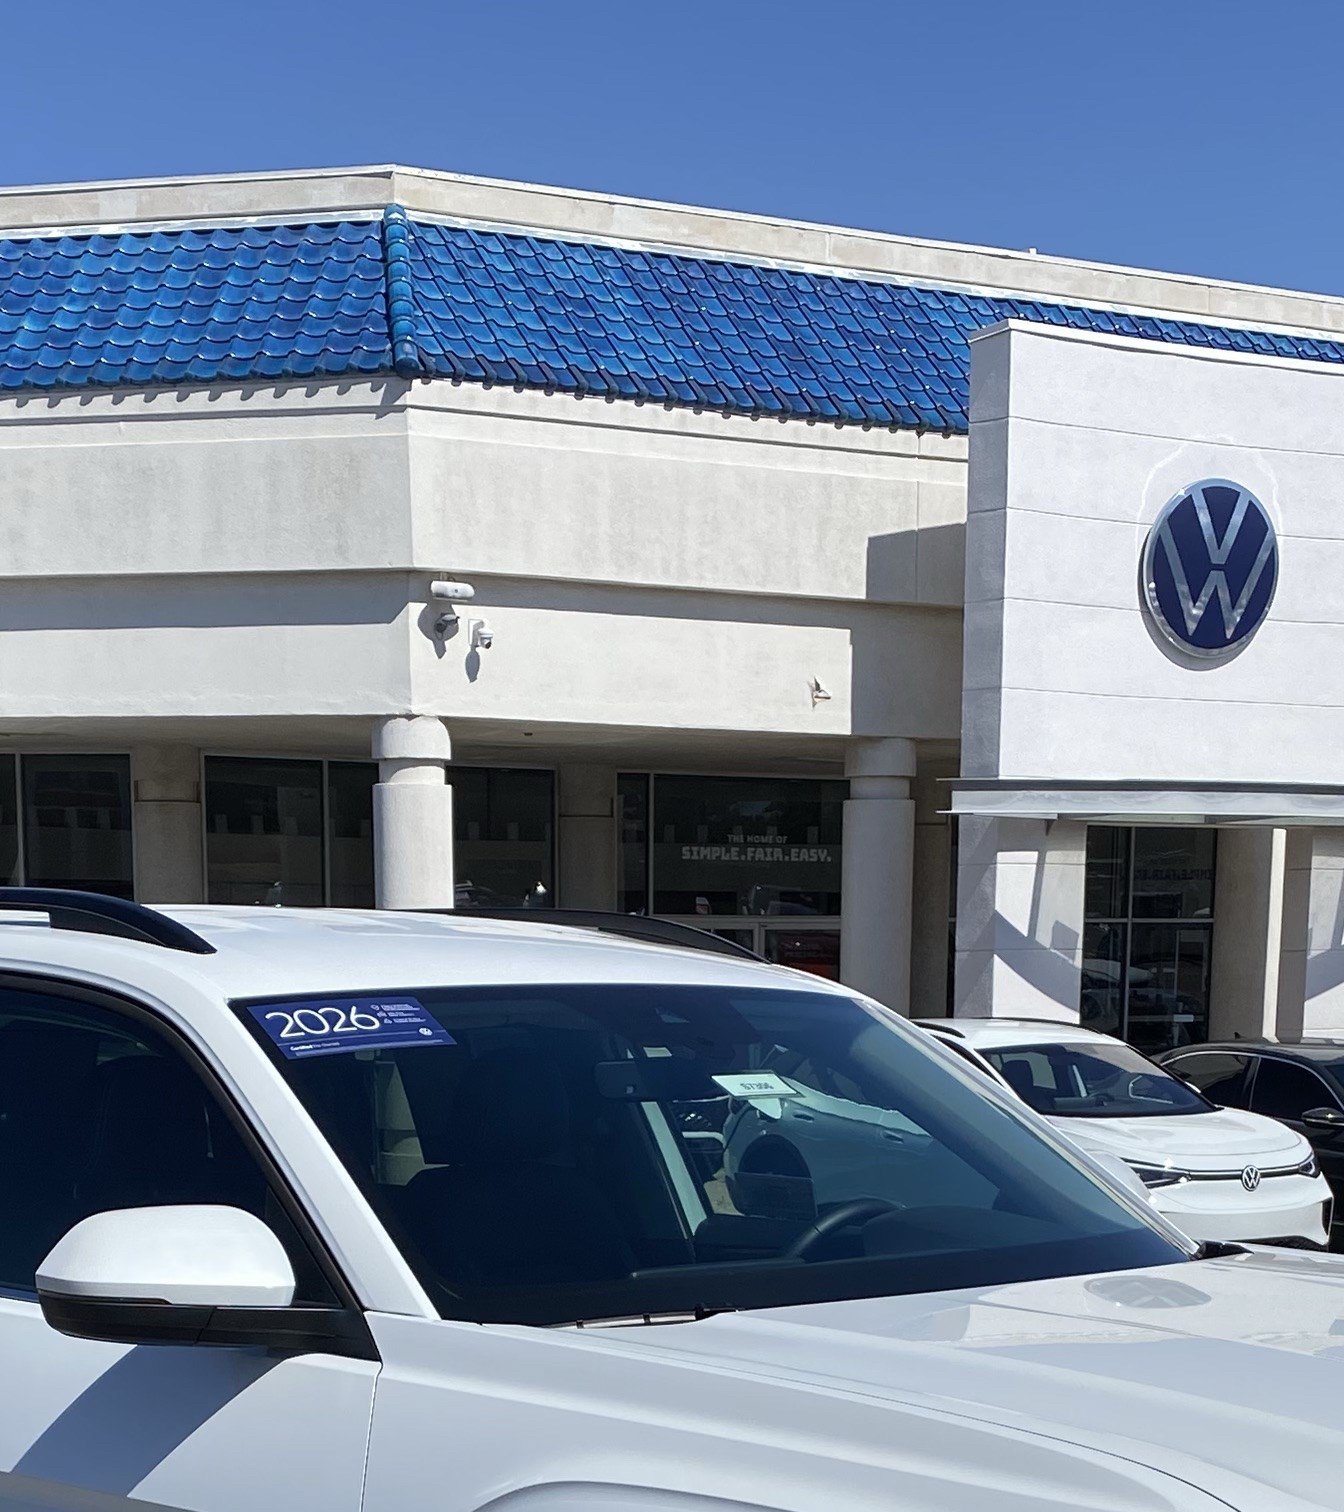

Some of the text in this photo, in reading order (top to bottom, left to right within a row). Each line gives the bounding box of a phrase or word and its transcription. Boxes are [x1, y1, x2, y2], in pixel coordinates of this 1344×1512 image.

[1143, 478, 1279, 658] VW
[727, 834, 744, 843] THE
[776, 835, 788, 844] OF
[264, 1005, 381, 1038] 2026
